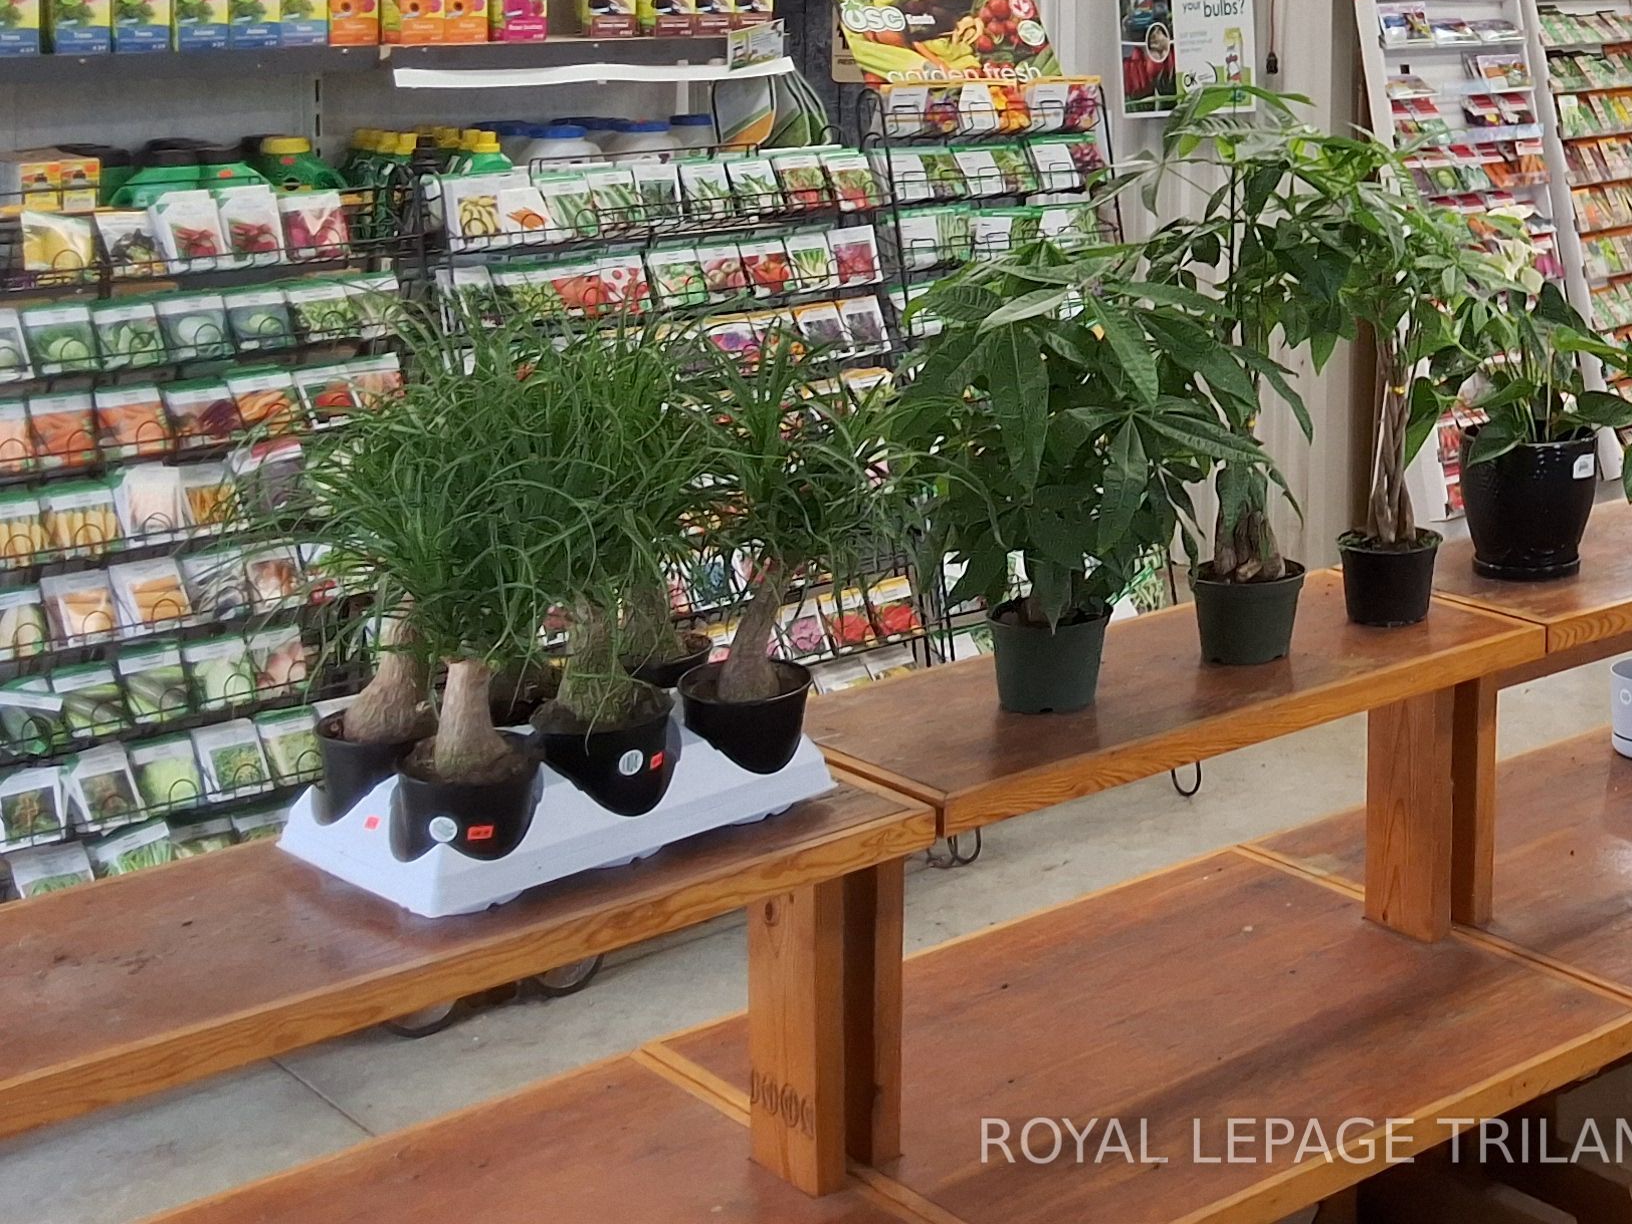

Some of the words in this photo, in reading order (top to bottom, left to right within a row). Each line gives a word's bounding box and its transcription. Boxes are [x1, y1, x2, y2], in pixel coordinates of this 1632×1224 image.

[842, 4, 905, 32] OSC
[1182, 1, 1202, 15] your
[982, 61, 1042, 83] fresh
